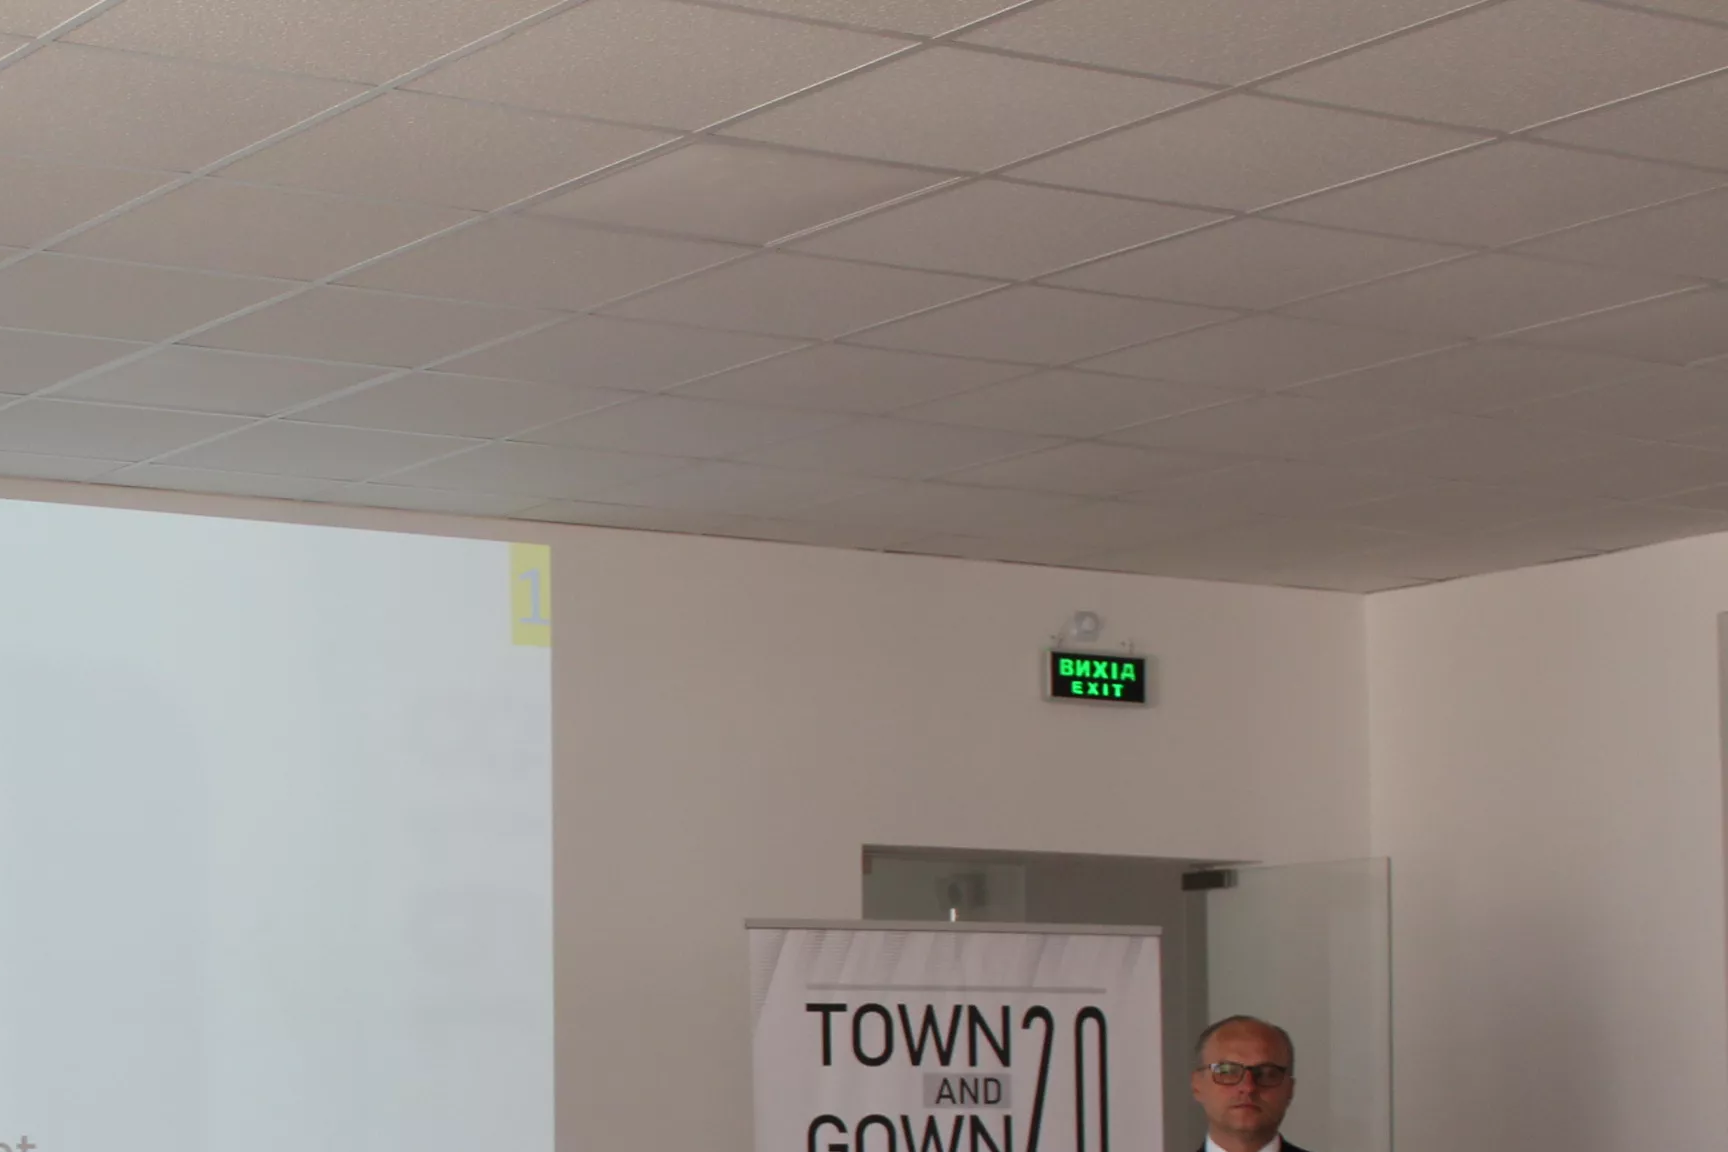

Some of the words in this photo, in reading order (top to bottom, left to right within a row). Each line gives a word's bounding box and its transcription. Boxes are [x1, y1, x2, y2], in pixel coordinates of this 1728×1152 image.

[518, 568, 551, 626] 1
[1071, 681, 1124, 697] EXIT
[806, 1003, 1011, 1067] TOWN
[935, 1077, 1003, 1105] AND
